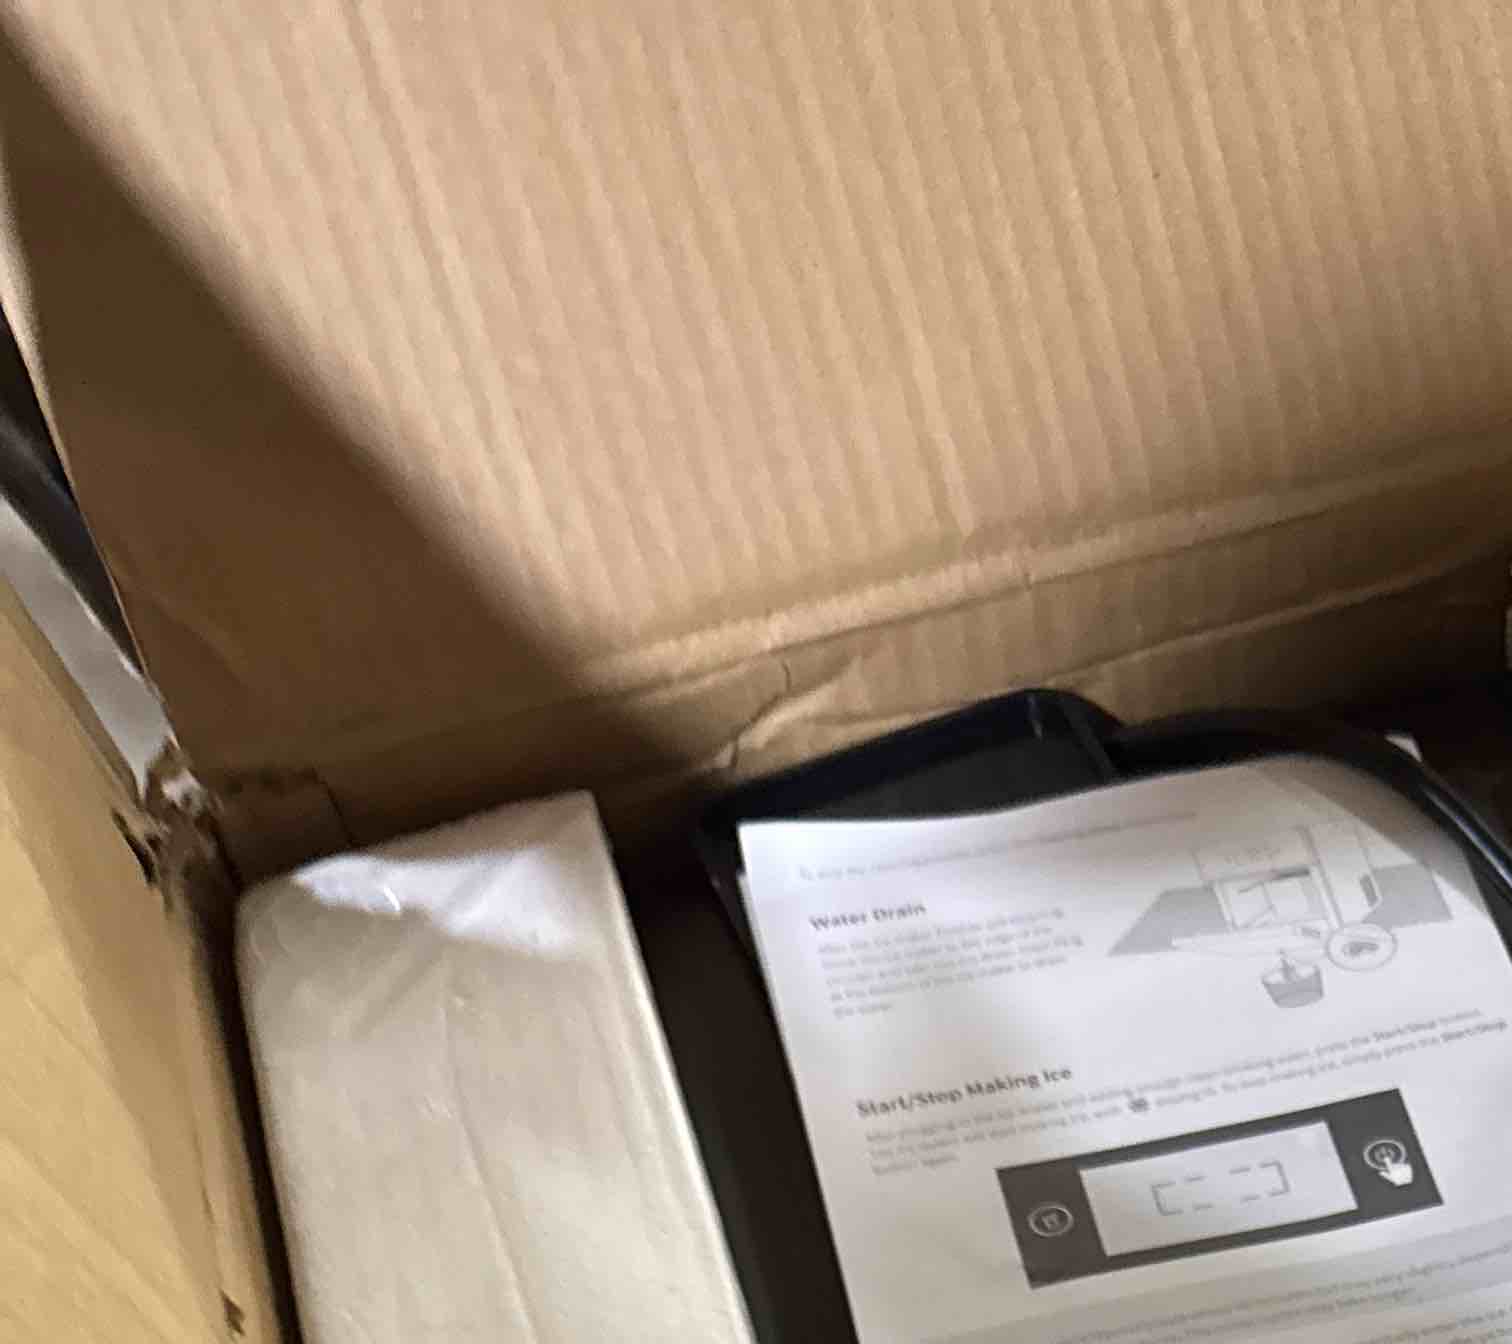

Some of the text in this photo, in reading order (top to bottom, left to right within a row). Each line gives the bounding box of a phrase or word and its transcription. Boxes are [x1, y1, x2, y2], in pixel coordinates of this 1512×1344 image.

[809, 902, 927, 931] Water Drain
[856, 1087, 963, 1117] Start/Stop
[965, 1075, 1040, 1099] Making
[1043, 1067, 1073, 1084] Ice
